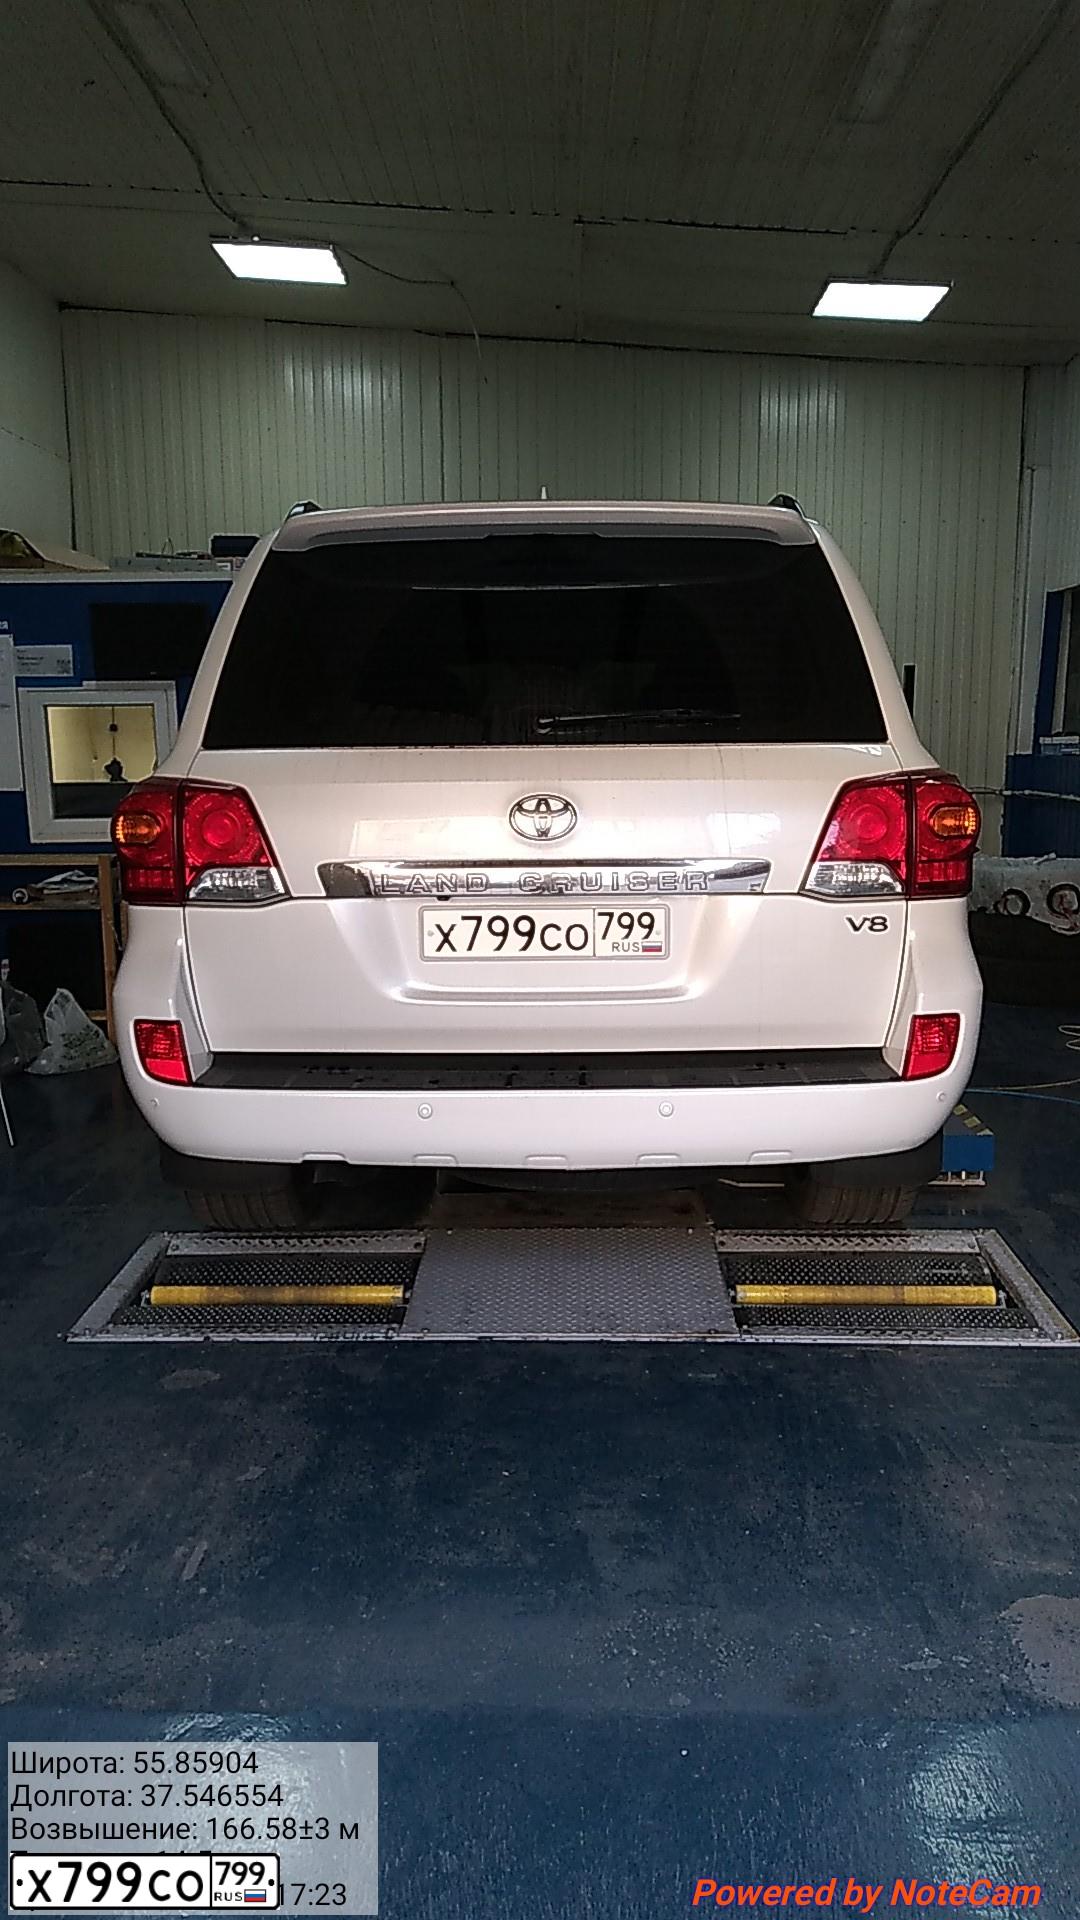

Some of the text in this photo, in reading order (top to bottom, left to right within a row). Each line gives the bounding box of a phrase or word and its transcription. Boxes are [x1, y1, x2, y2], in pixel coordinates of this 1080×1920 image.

[380, 871, 709, 894] LAND CRUISER
[597, 911, 656, 941] 799
[845, 915, 889, 932] V8
[611, 941, 640, 953] RUS
